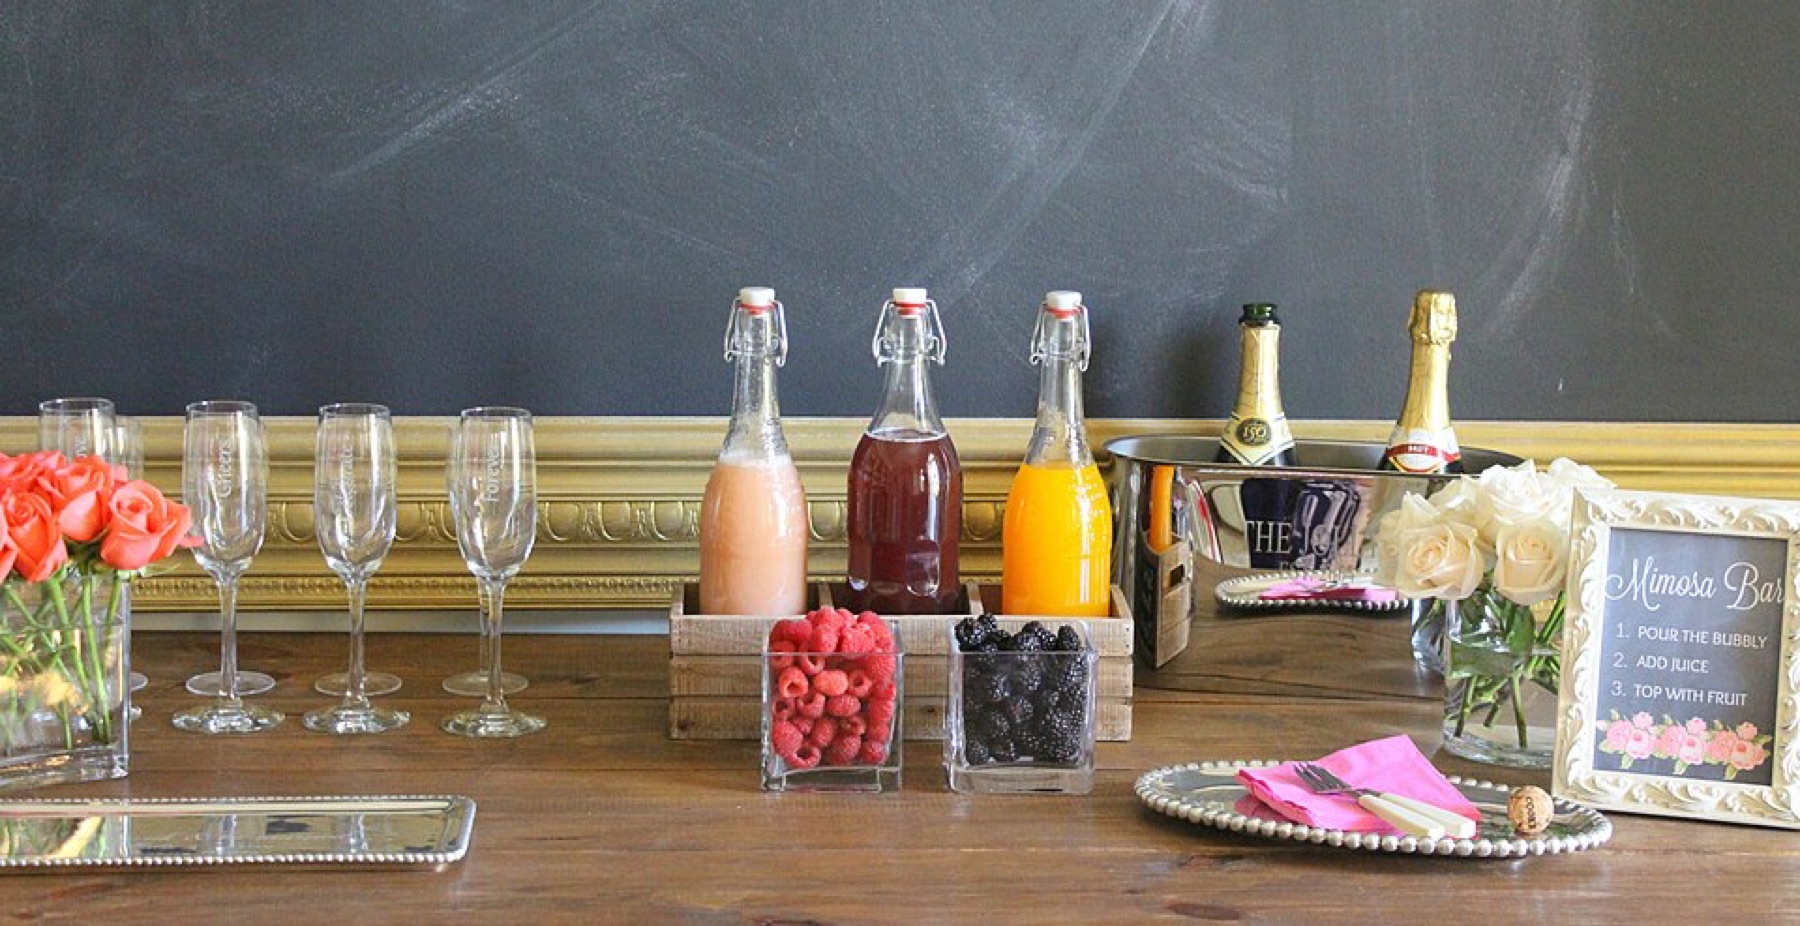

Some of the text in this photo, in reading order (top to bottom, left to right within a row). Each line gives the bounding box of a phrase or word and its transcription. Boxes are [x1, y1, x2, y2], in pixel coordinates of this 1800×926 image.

[1244, 520, 1293, 554] THE
[1604, 556, 1785, 611] Mimosa Bar
[1615, 622, 1768, 650] 1. POUR THE BUBBLY
[1612, 652, 1710, 674] 2. ADD JUICE
[1611, 681, 1749, 706] 3. TOP WITH FRUIT
